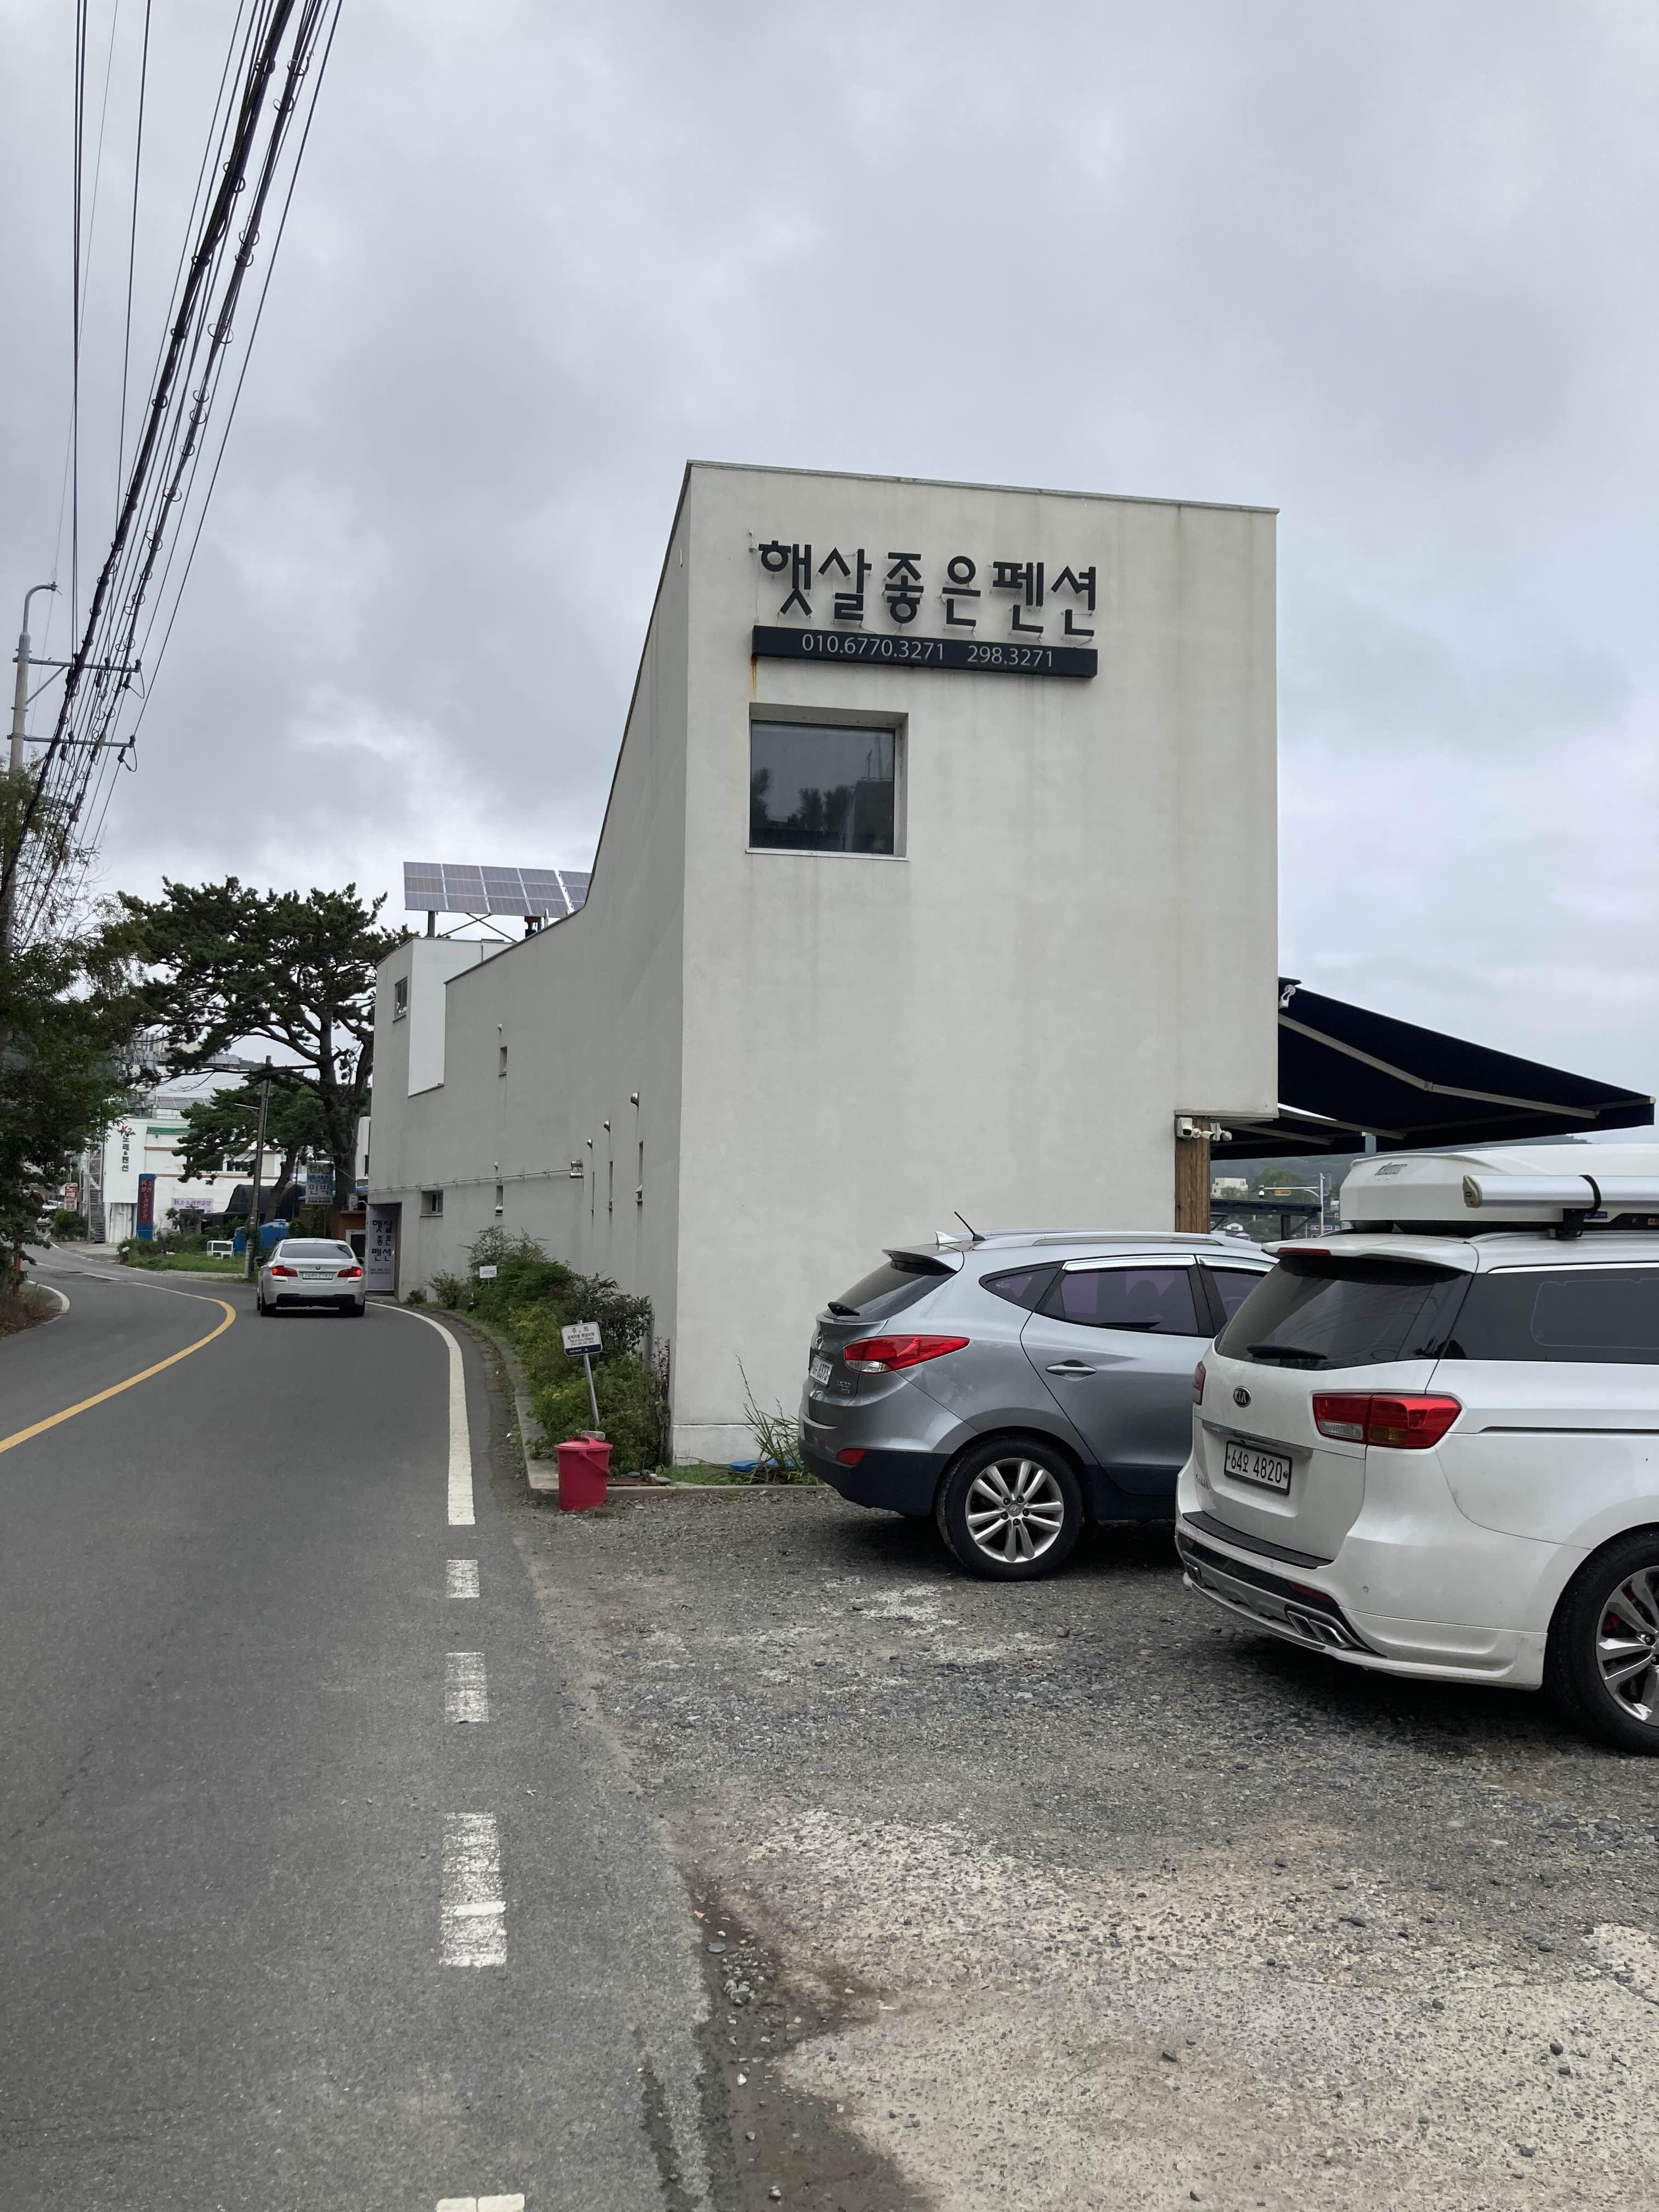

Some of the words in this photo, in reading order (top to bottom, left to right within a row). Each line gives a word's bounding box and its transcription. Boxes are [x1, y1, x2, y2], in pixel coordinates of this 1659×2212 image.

[758, 540, 1096, 637] 햇살좋은펜션
[802, 634, 943, 660] 010.6770.3271
[967, 645, 1052, 667] 298.3271
[309, 1185, 329, 1195] 민박
[373, 1220, 392, 1233] 햇살
[377, 1235, 391, 1246] 좋은
[371, 1248, 391, 1261] 펜션
[1234, 1390, 1247, 1404] KIA
[1231, 1449, 1249, 1473] 64오
[1253, 1456, 1283, 1483] 4820
